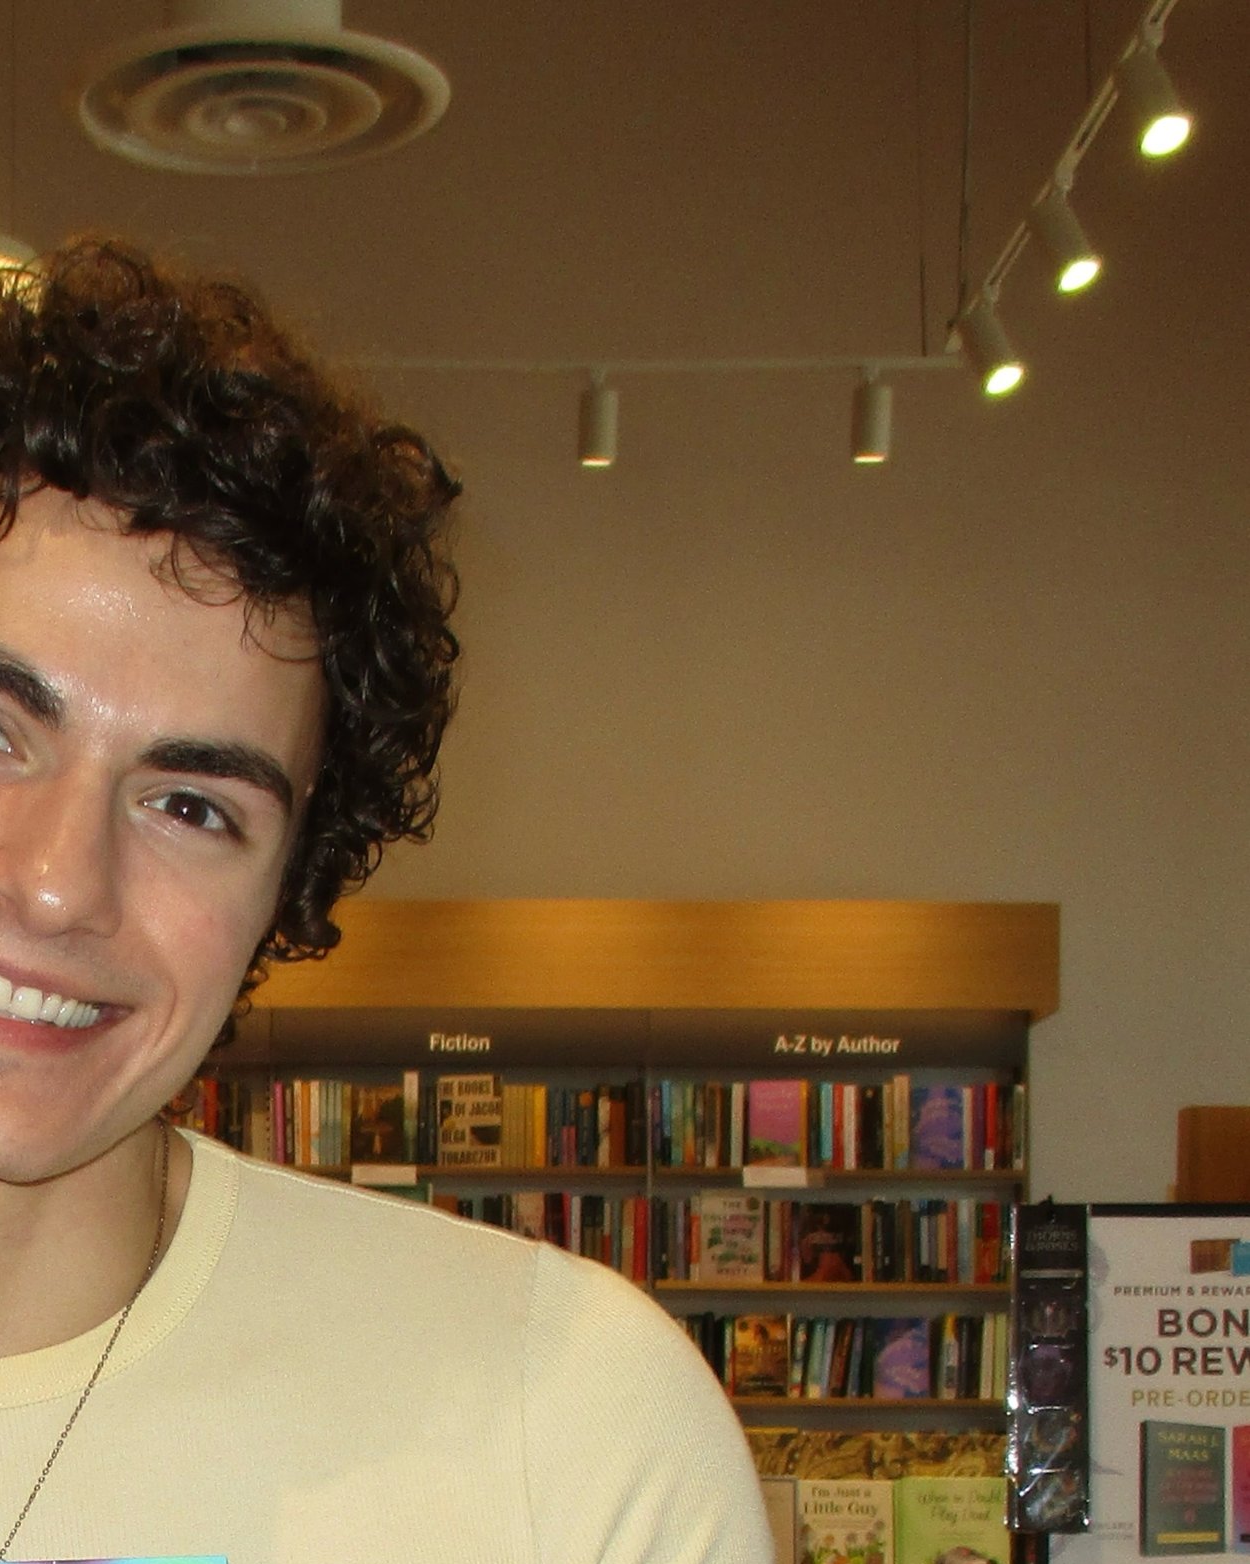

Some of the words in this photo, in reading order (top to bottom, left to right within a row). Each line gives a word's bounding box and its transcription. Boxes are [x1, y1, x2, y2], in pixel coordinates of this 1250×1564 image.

[429, 1032, 491, 1053] Fiction
[774, 1035, 807, 1054] A-Z
[809, 1034, 832, 1057] by
[836, 1034, 901, 1054] Author
[1113, 1286, 1181, 1297] PREMIUM
[1186, 1286, 1196, 1297] &
[1157, 1308, 1250, 1339] BON
[1103, 1345, 1162, 1377] $10
[804, 1502, 840, 1515] Little
[847, 1502, 878, 1517] Guy
